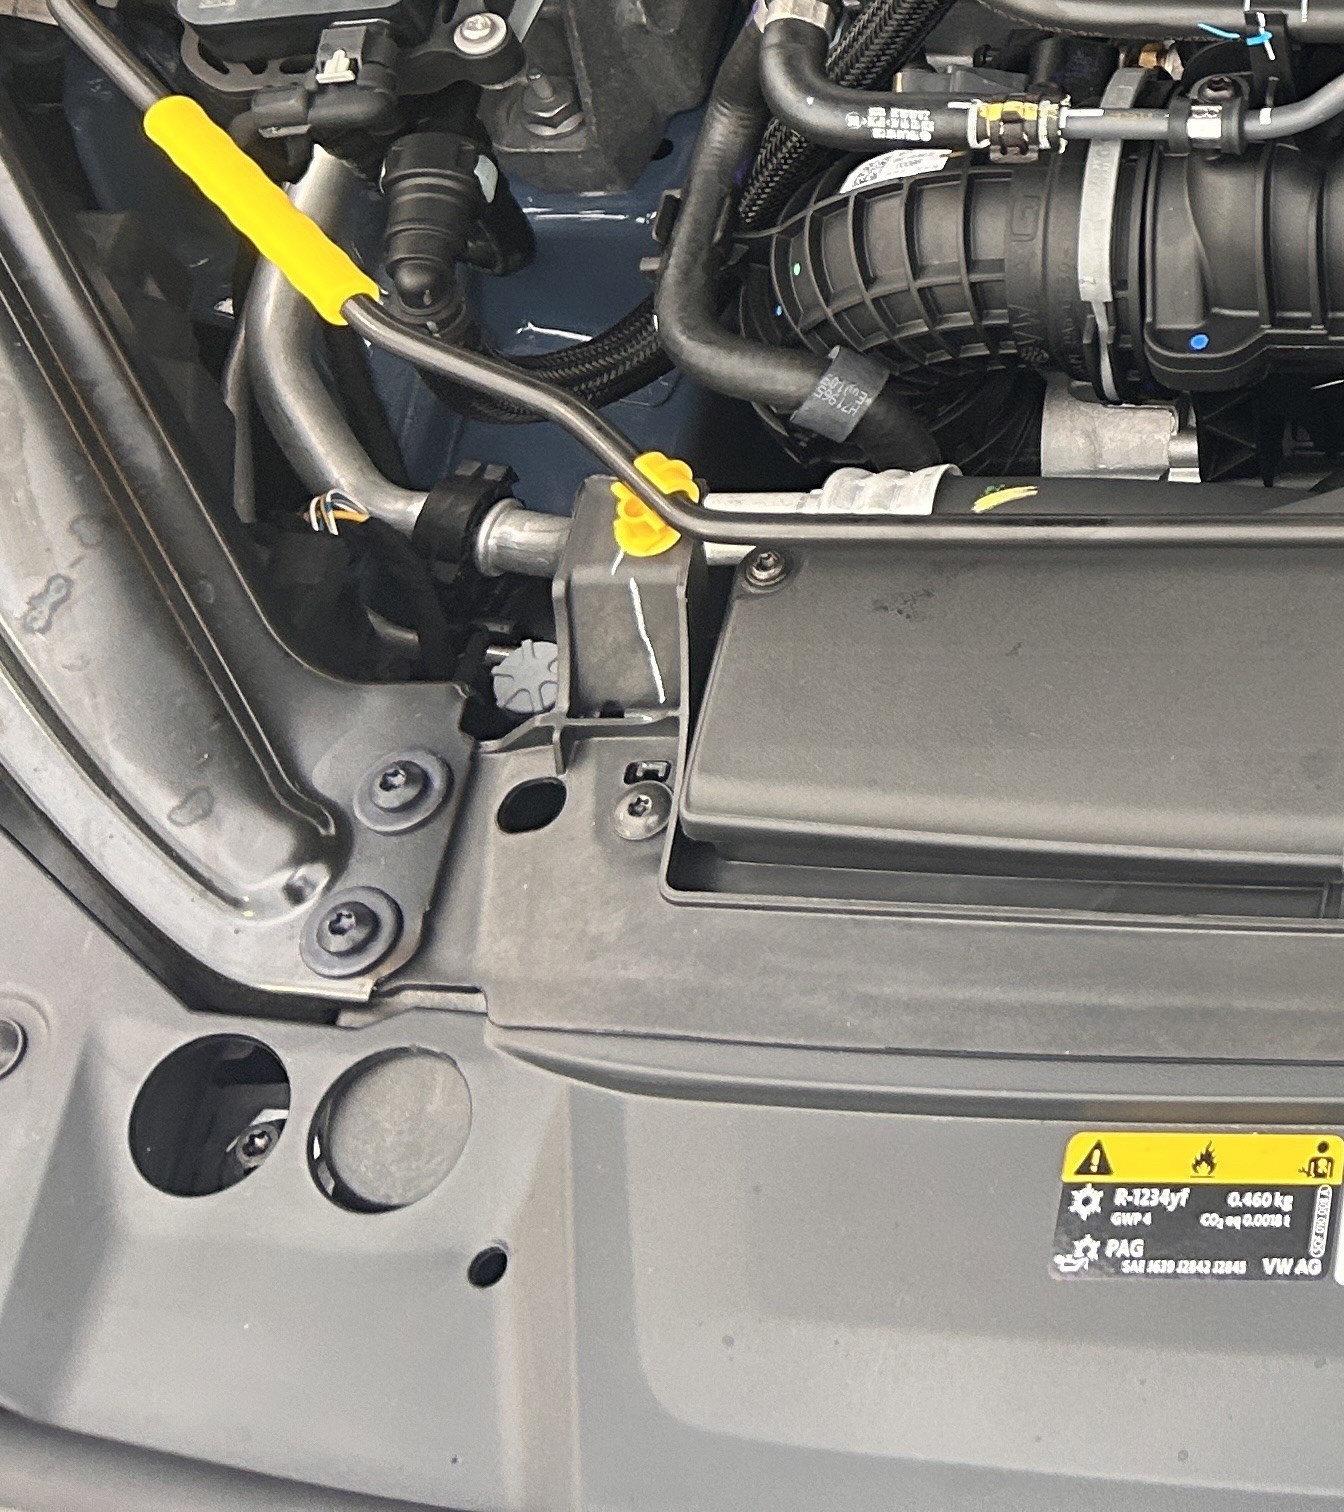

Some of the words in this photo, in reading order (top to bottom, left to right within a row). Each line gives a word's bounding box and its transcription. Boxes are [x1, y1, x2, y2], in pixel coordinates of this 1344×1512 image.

[1113, 1188, 1190, 1210] R-1234yf
[1274, 1192, 1294, 1211] kg
[1110, 1212, 1141, 1226] GWP
[1225, 1216, 1242, 1229] eq
[1283, 1215, 1291, 1228] t
[1105, 1239, 1144, 1257] PAG
[1262, 1258, 1295, 1275] VW
[1296, 1258, 1322, 1276] AG
